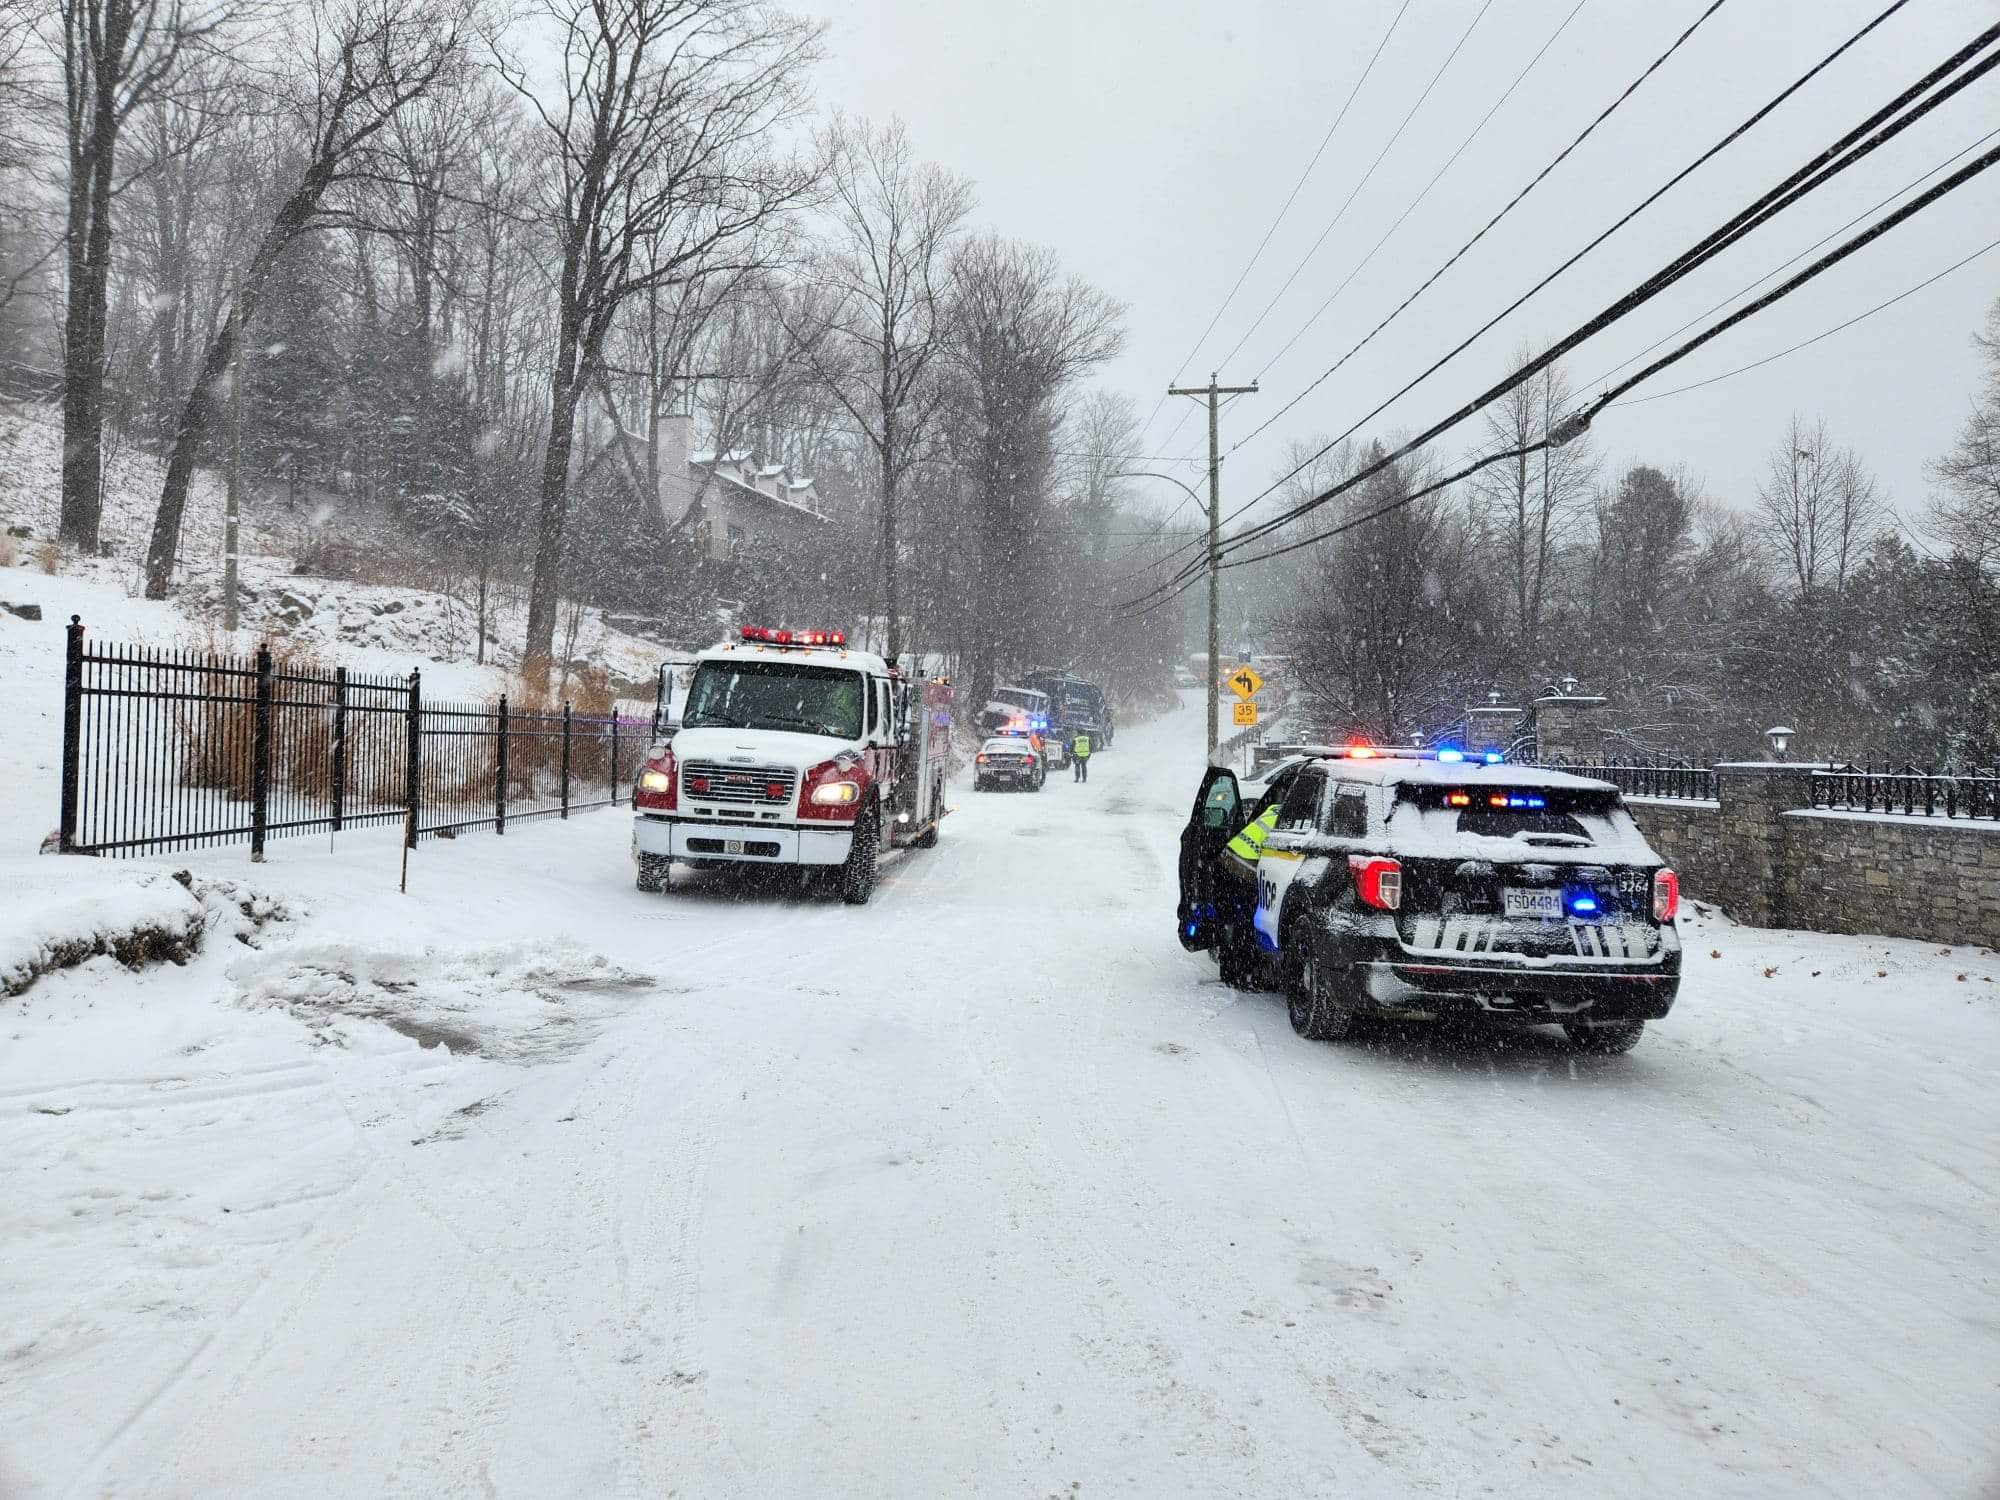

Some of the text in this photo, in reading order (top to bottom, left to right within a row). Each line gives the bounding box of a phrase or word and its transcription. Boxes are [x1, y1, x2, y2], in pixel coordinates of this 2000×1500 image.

[1238, 705, 1253, 716] 35
[1259, 869, 1276, 911] lice
[1620, 880, 1649, 893] 3264
